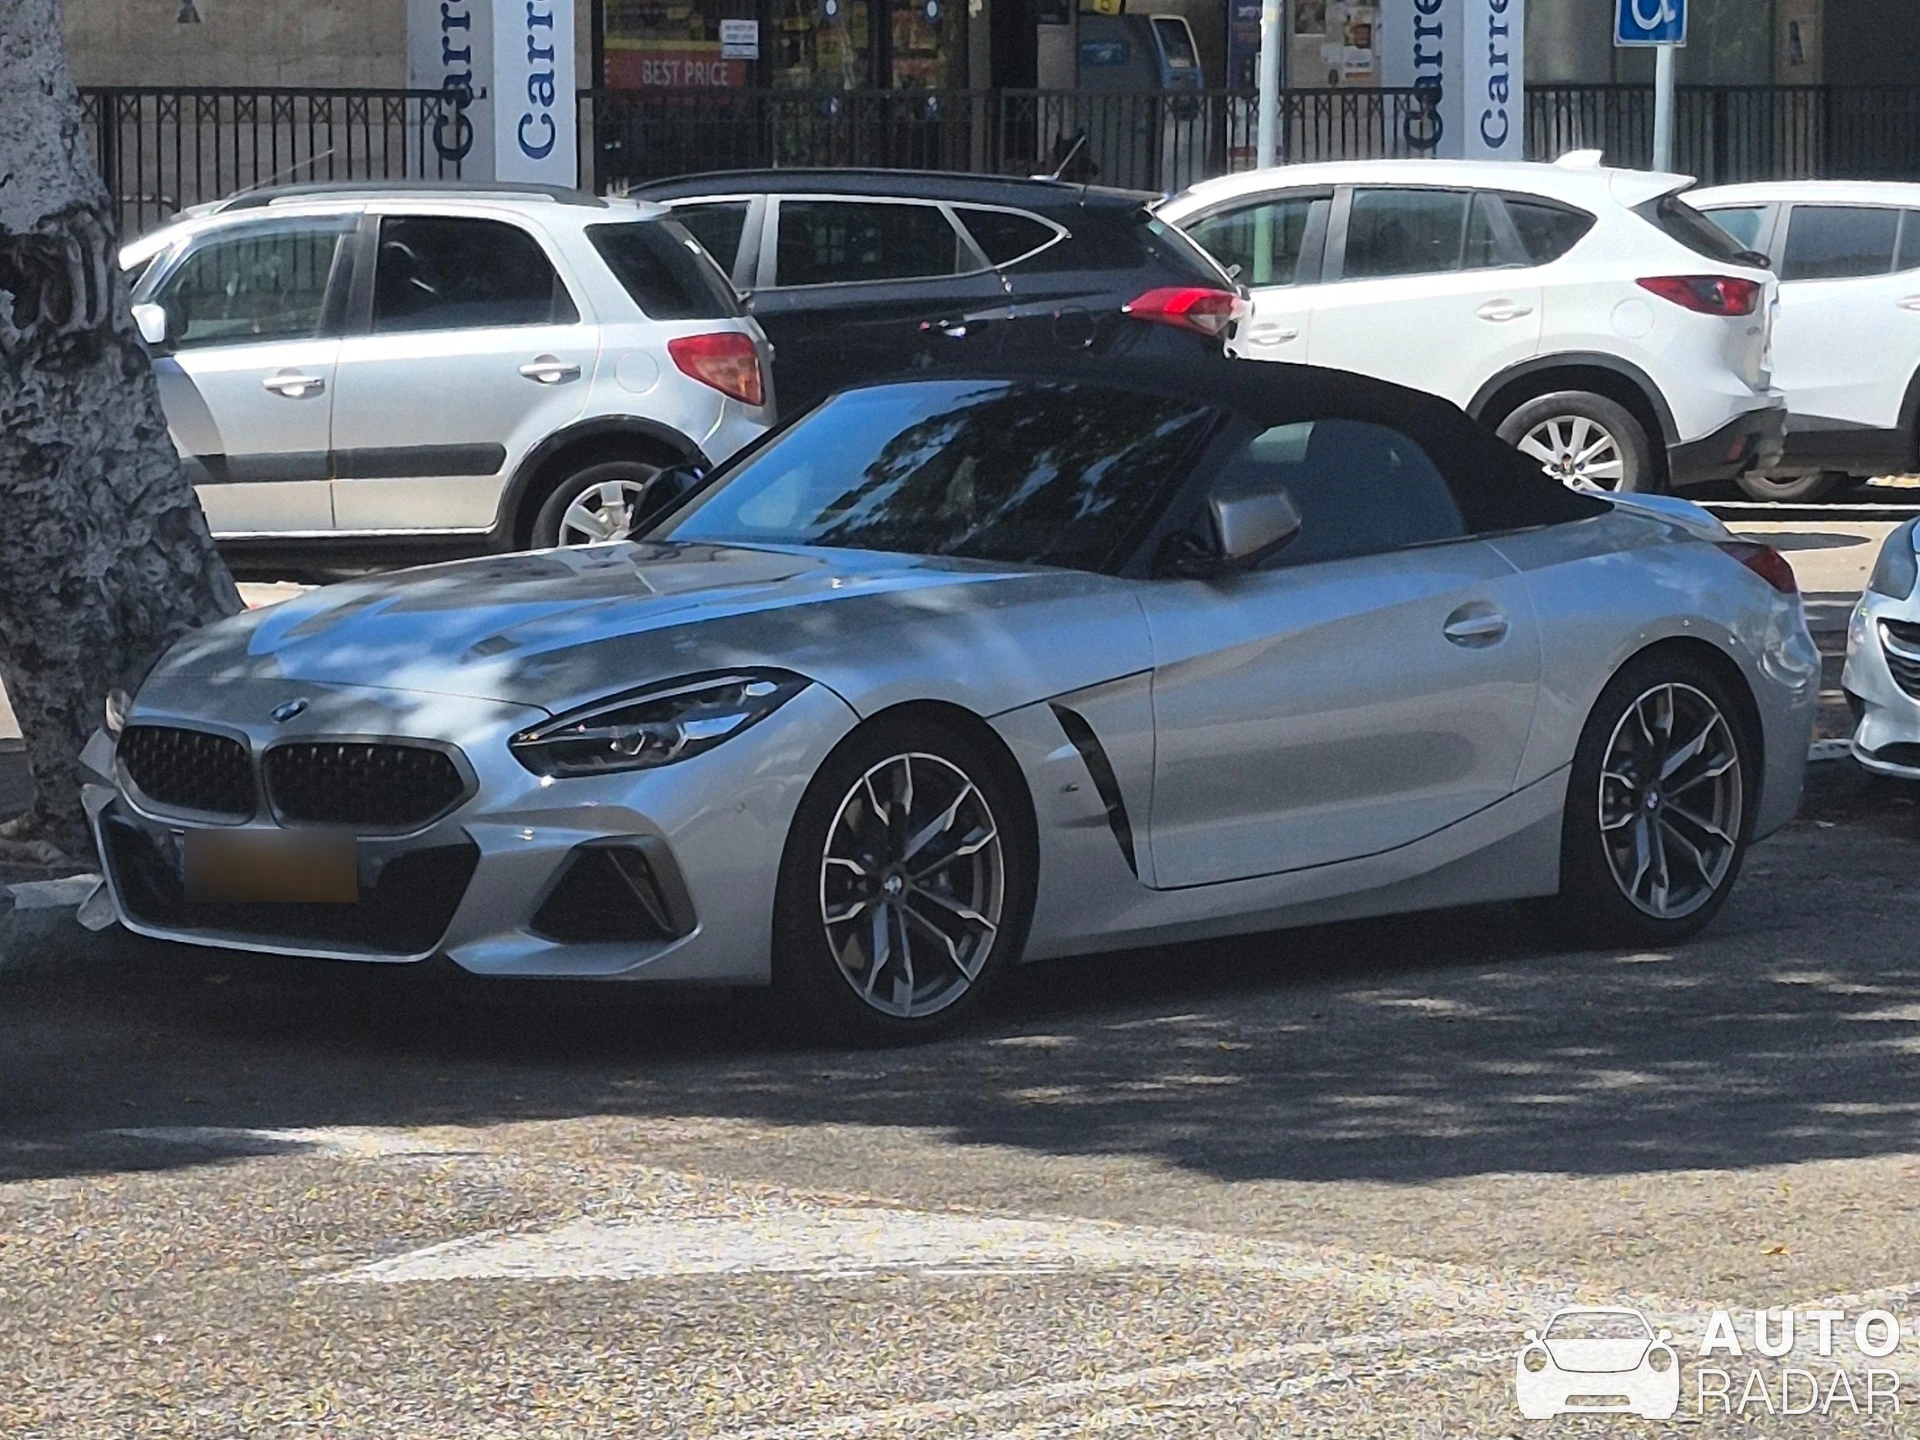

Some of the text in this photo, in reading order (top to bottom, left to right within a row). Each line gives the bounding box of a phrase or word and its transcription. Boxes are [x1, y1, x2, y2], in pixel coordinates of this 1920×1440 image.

[433, 0, 474, 160] Carr
[641, 60, 679, 86] BEST
[685, 61, 728, 86] PRICE
